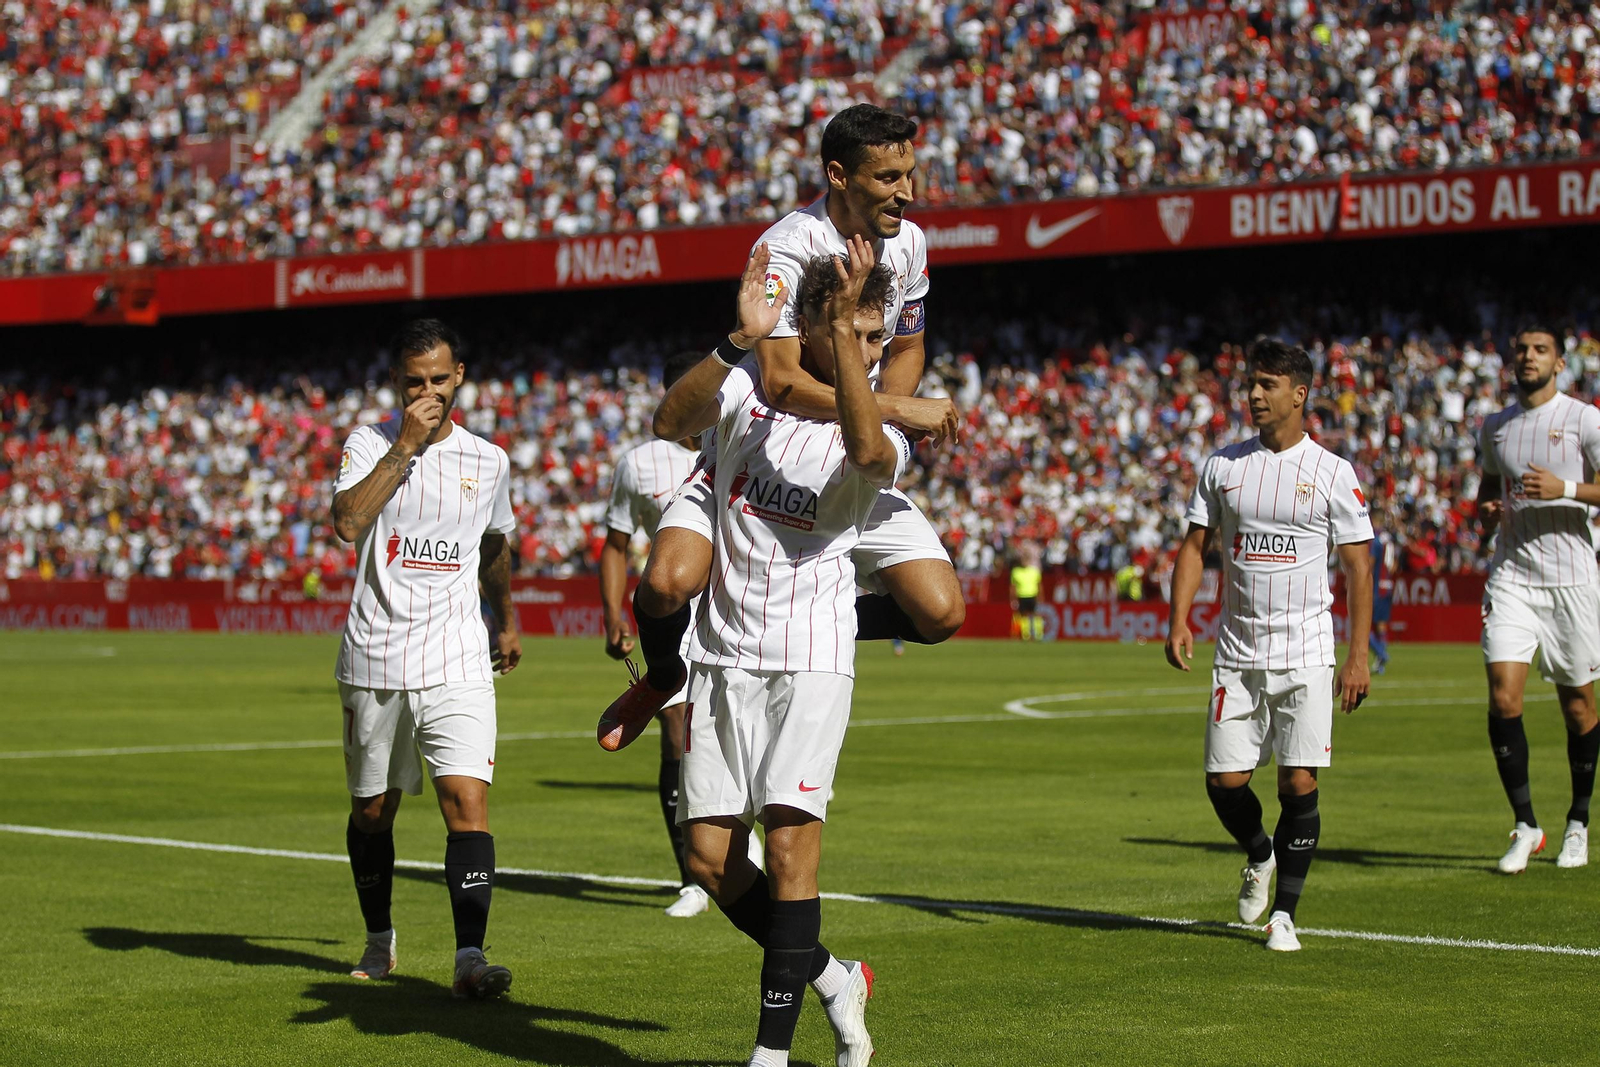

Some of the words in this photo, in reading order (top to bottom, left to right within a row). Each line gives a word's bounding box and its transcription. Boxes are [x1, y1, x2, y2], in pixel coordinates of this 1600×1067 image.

[1231, 179, 1475, 237] BIENVENIDOS
[1490, 175, 1541, 219] AL
[572, 235, 661, 282] NAGA
[746, 476, 818, 520] NAGA
[759, 511, 784, 523] Investing
[784, 517, 799, 527] Super
[403, 536, 460, 562] NAGA
[1245, 533, 1297, 554] NAGA
[1063, 604, 1162, 643] LaLiga
[466, 872, 488, 880] SFC
[767, 990, 793, 1001] SFC
